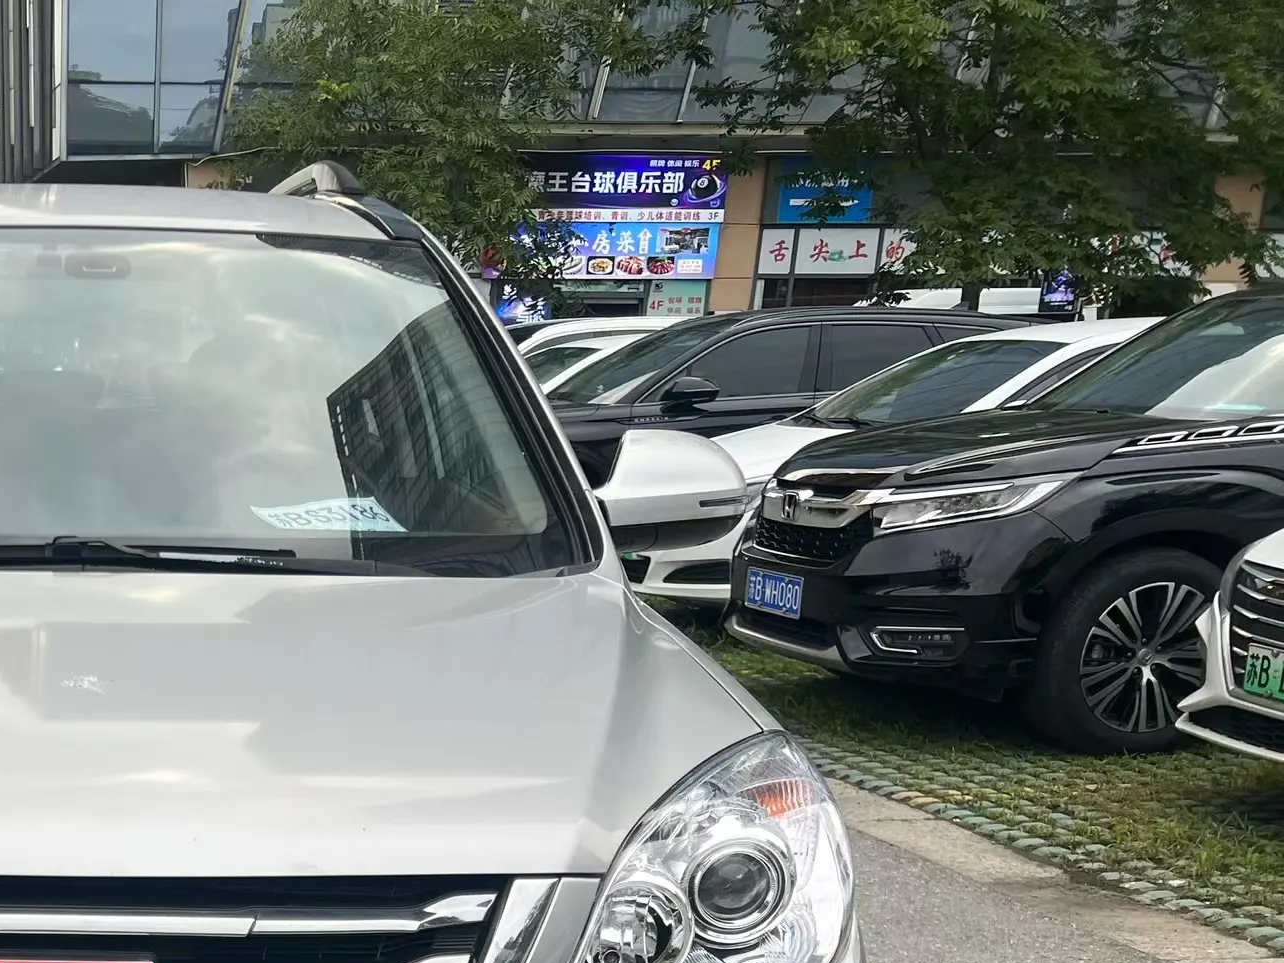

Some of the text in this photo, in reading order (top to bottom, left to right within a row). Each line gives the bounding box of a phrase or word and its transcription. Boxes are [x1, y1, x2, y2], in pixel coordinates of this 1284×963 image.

[684, 160, 700, 168] 娱乐
[708, 212, 719, 220] 3F
[769, 240, 905, 263] 舌尖上的
[649, 300, 664, 310] 4F
